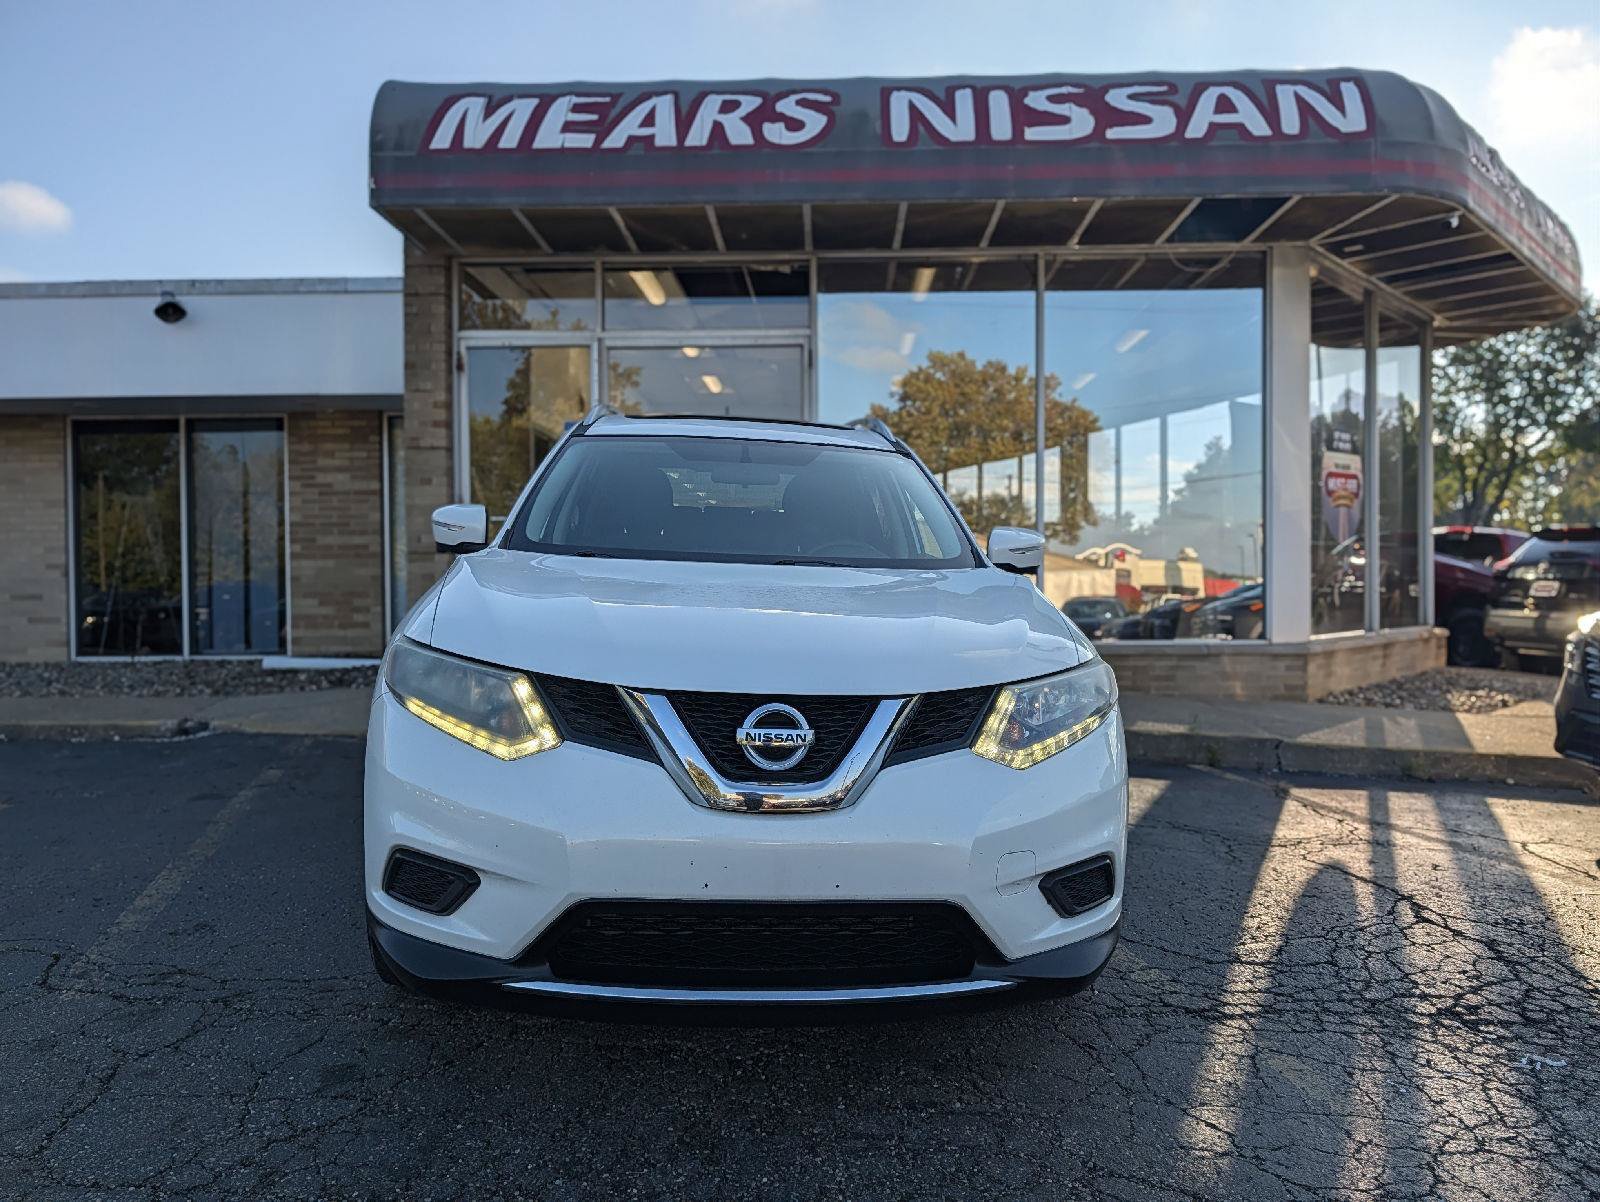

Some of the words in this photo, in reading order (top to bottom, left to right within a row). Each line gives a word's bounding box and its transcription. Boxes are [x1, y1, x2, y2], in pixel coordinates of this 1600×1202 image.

[428, 92, 833, 150] MEARS
[889, 80, 1368, 142] NISSAN
[745, 731, 807, 743] NISSAN
